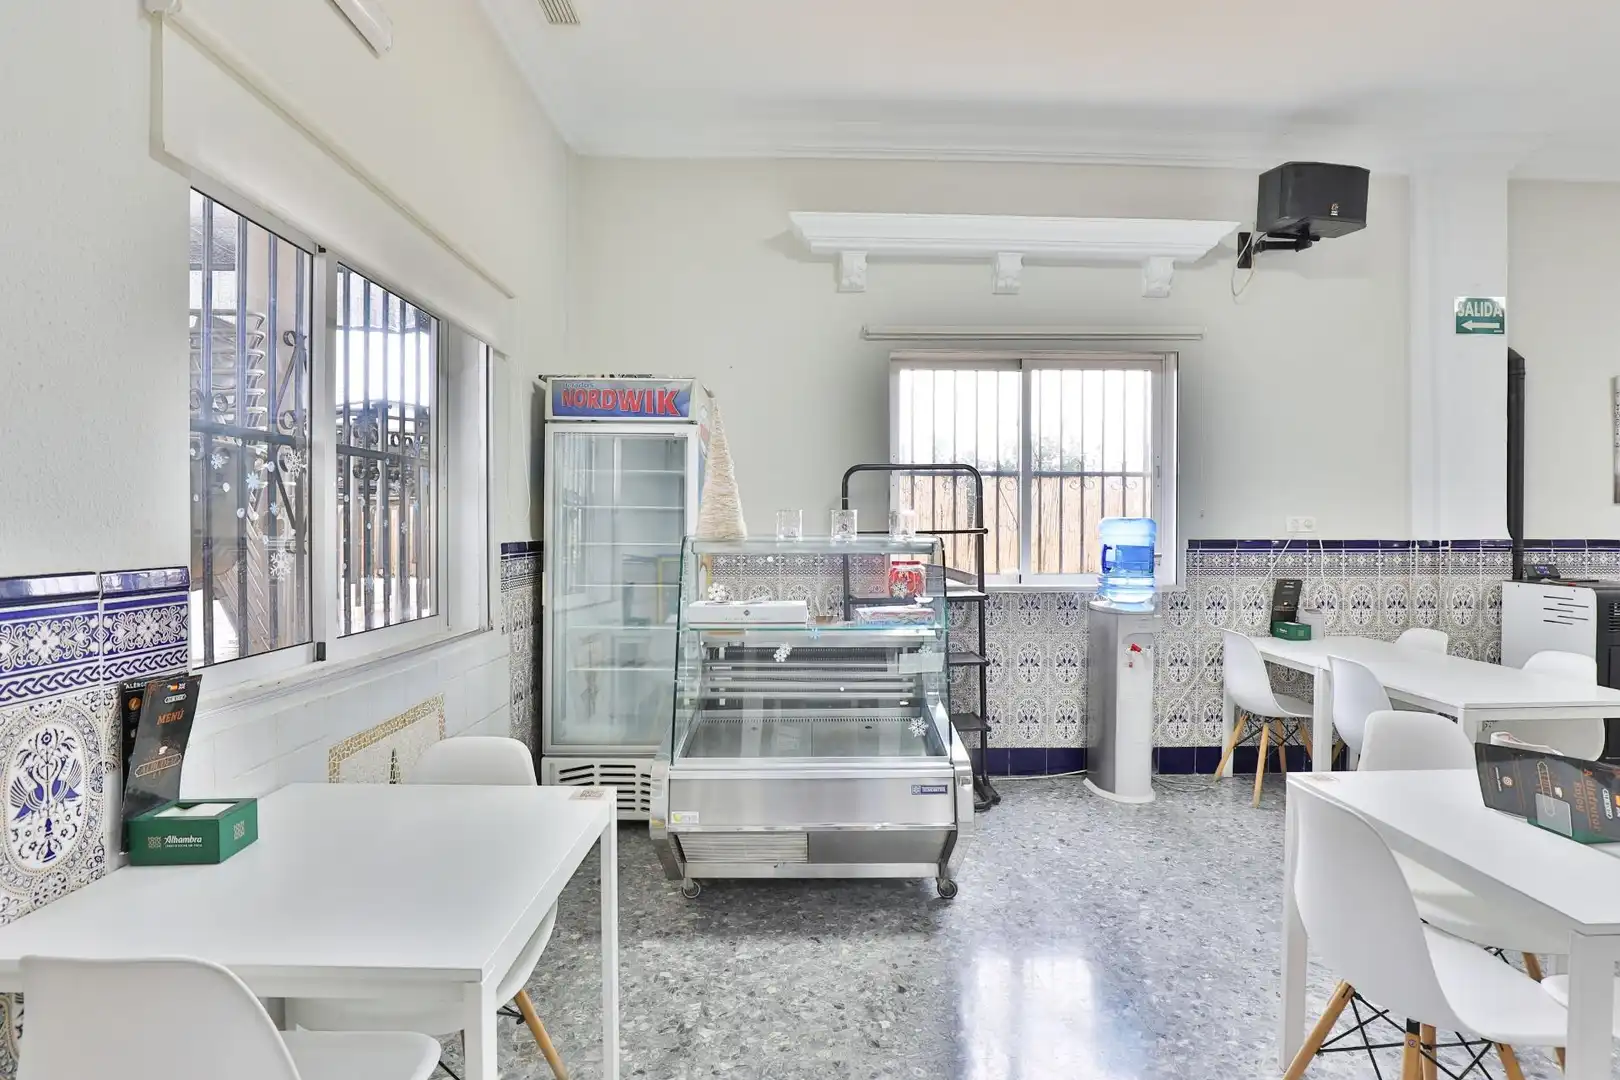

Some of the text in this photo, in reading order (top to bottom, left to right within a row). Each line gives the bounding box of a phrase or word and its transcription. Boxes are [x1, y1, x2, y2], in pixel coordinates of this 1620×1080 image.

[1457, 301, 1503, 317] SALIDA
[561, 388, 681, 417] NORDWIK
[156, 708, 184, 725] MENÚ
[1586, 779, 1602, 832] disfrutar
[164, 835, 203, 844] Alhambra
